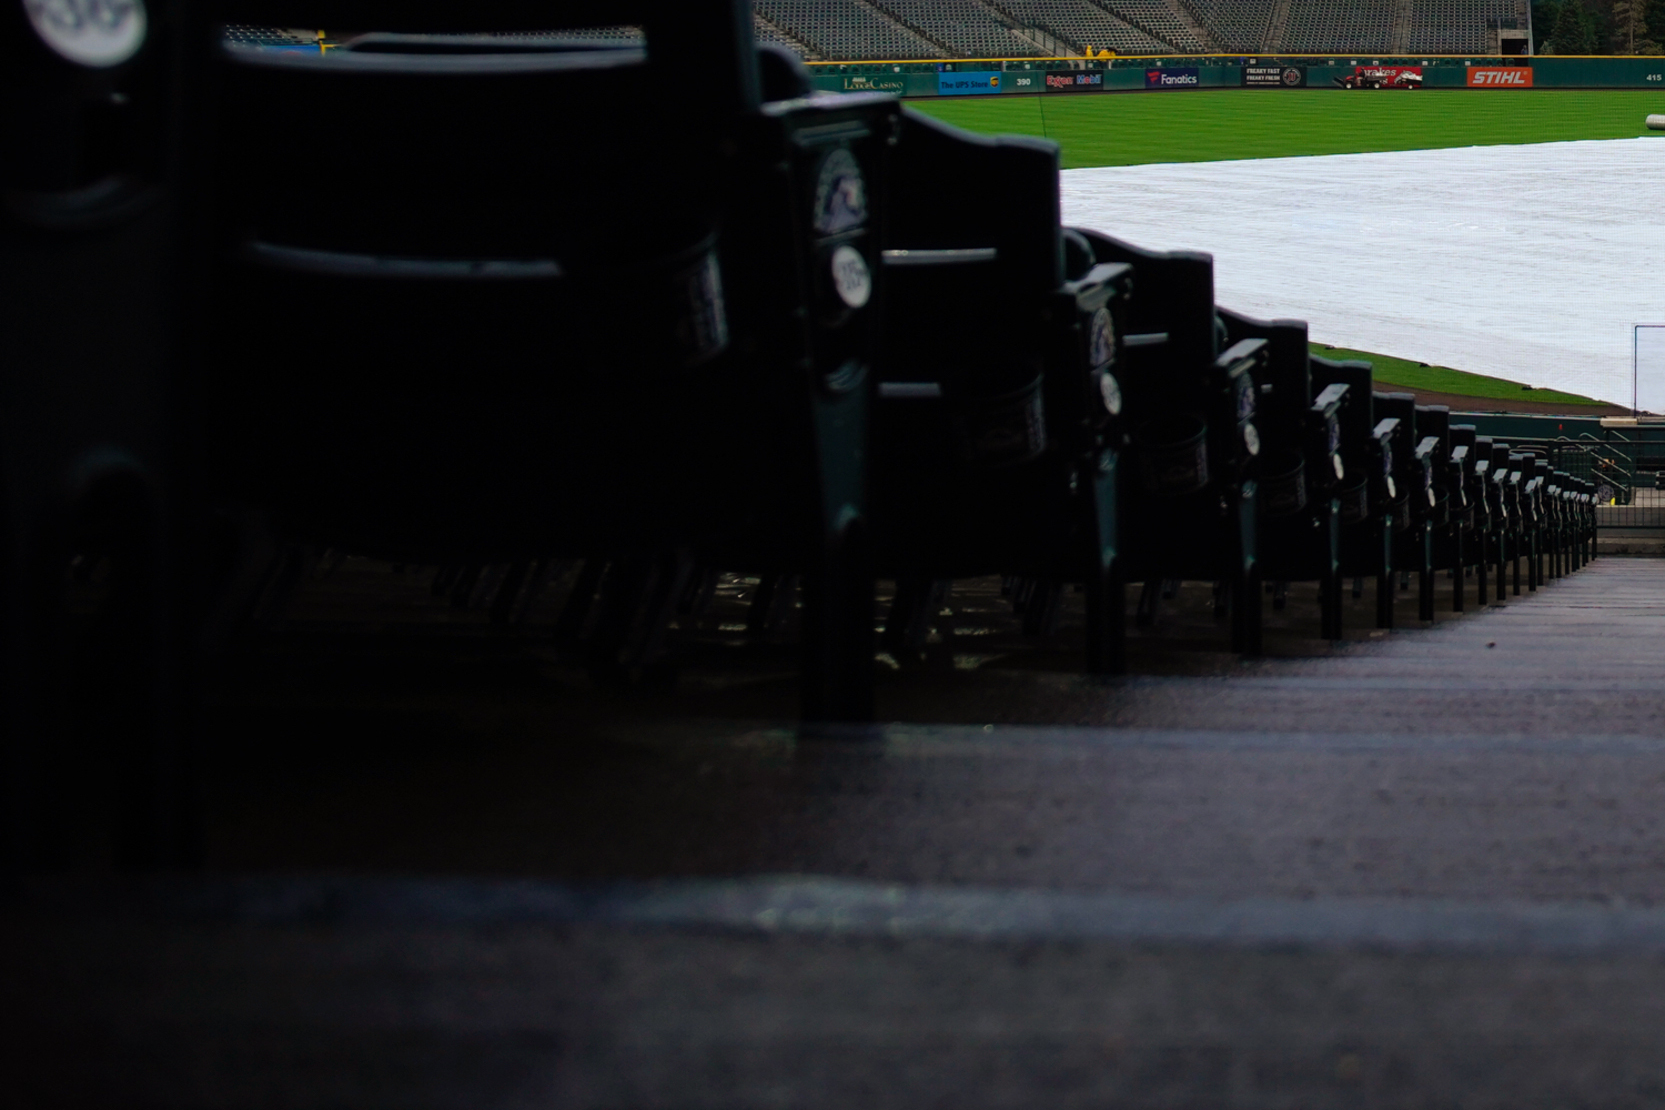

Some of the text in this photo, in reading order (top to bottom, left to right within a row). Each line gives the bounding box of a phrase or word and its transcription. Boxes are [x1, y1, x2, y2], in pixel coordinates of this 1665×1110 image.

[1017, 78, 1031, 86] 390
[1046, 74, 1102, 88] Exxon Mobil
[1160, 74, 1198, 85] Fanatics
[1472, 71, 1526, 84] STIHL
[941, 81, 953, 89] The
[956, 81, 969, 89] UPS
